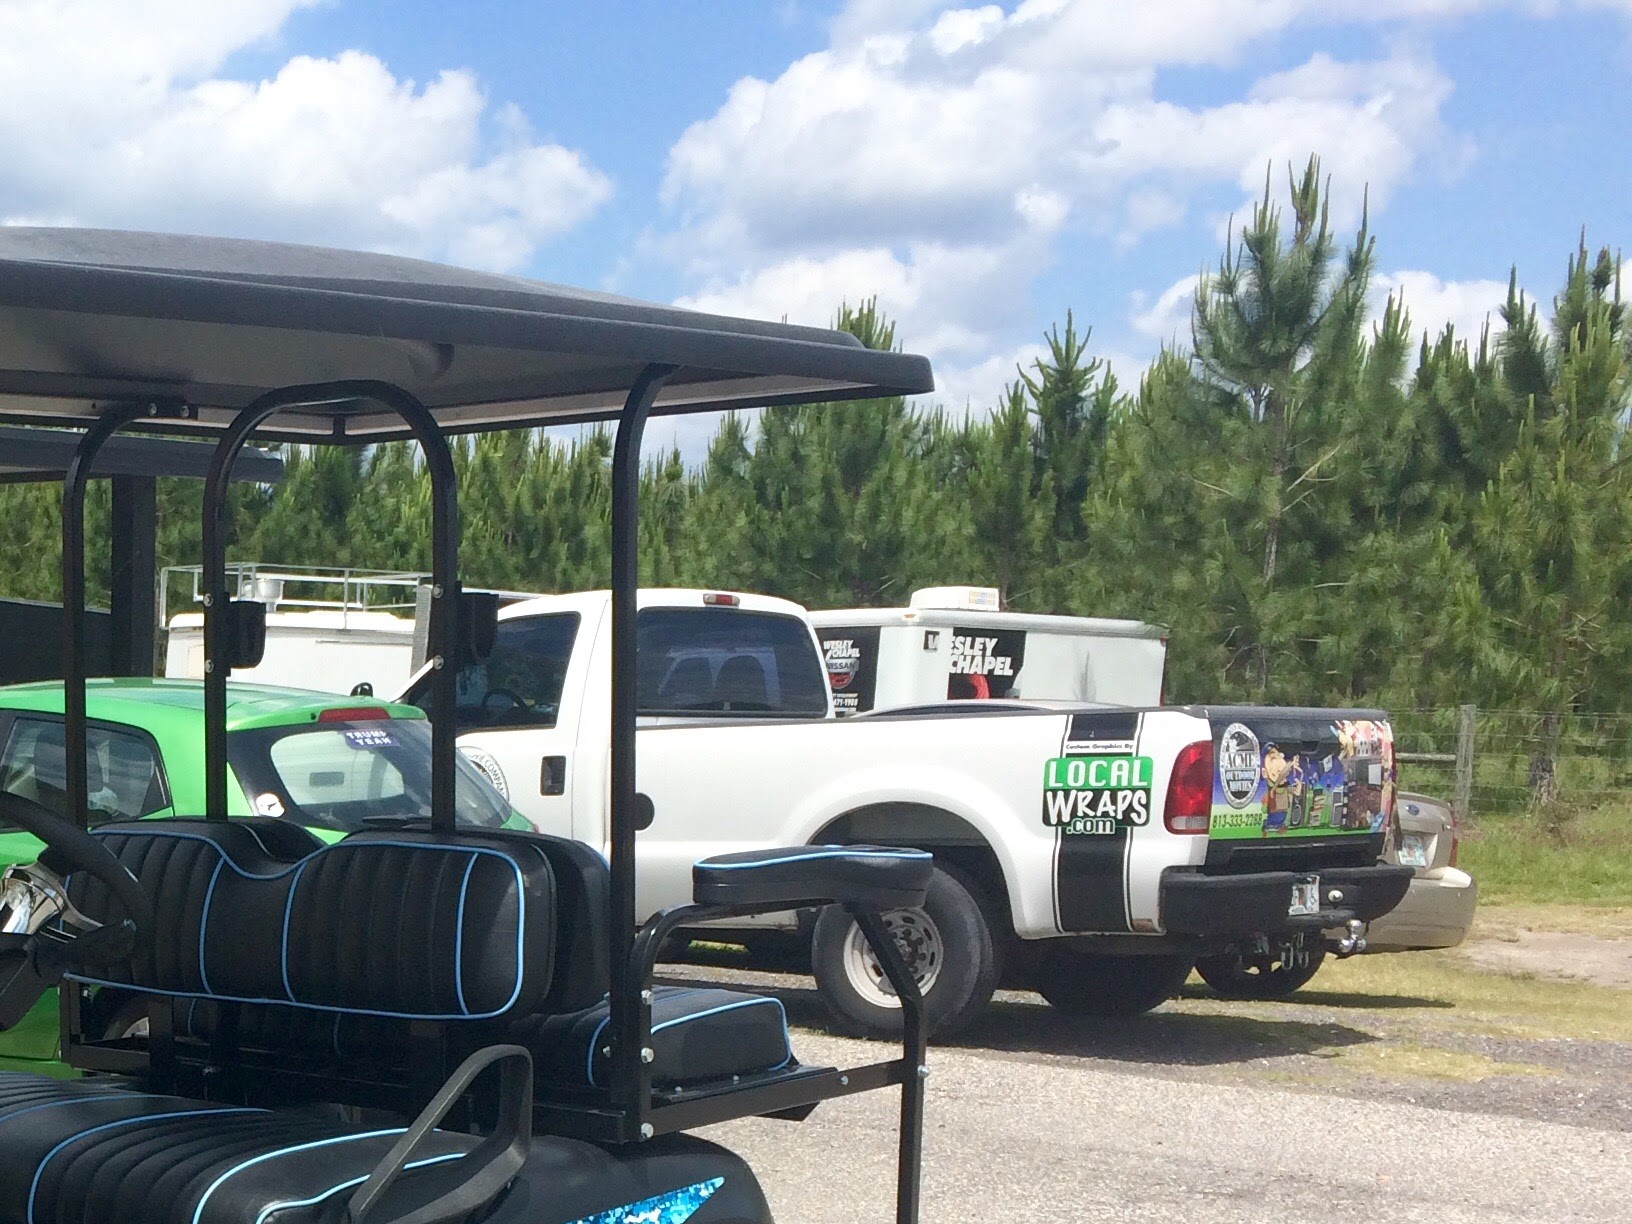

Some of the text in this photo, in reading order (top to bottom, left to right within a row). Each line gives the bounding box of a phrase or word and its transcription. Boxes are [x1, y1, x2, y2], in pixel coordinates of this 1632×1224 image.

[950, 654, 1014, 676] CHAPEL
[1227, 752, 1254, 769] ACME
[1048, 759, 1148, 788] LOCAL
[1046, 789, 1148, 825] WRAPS
[1066, 817, 1116, 835] .com
